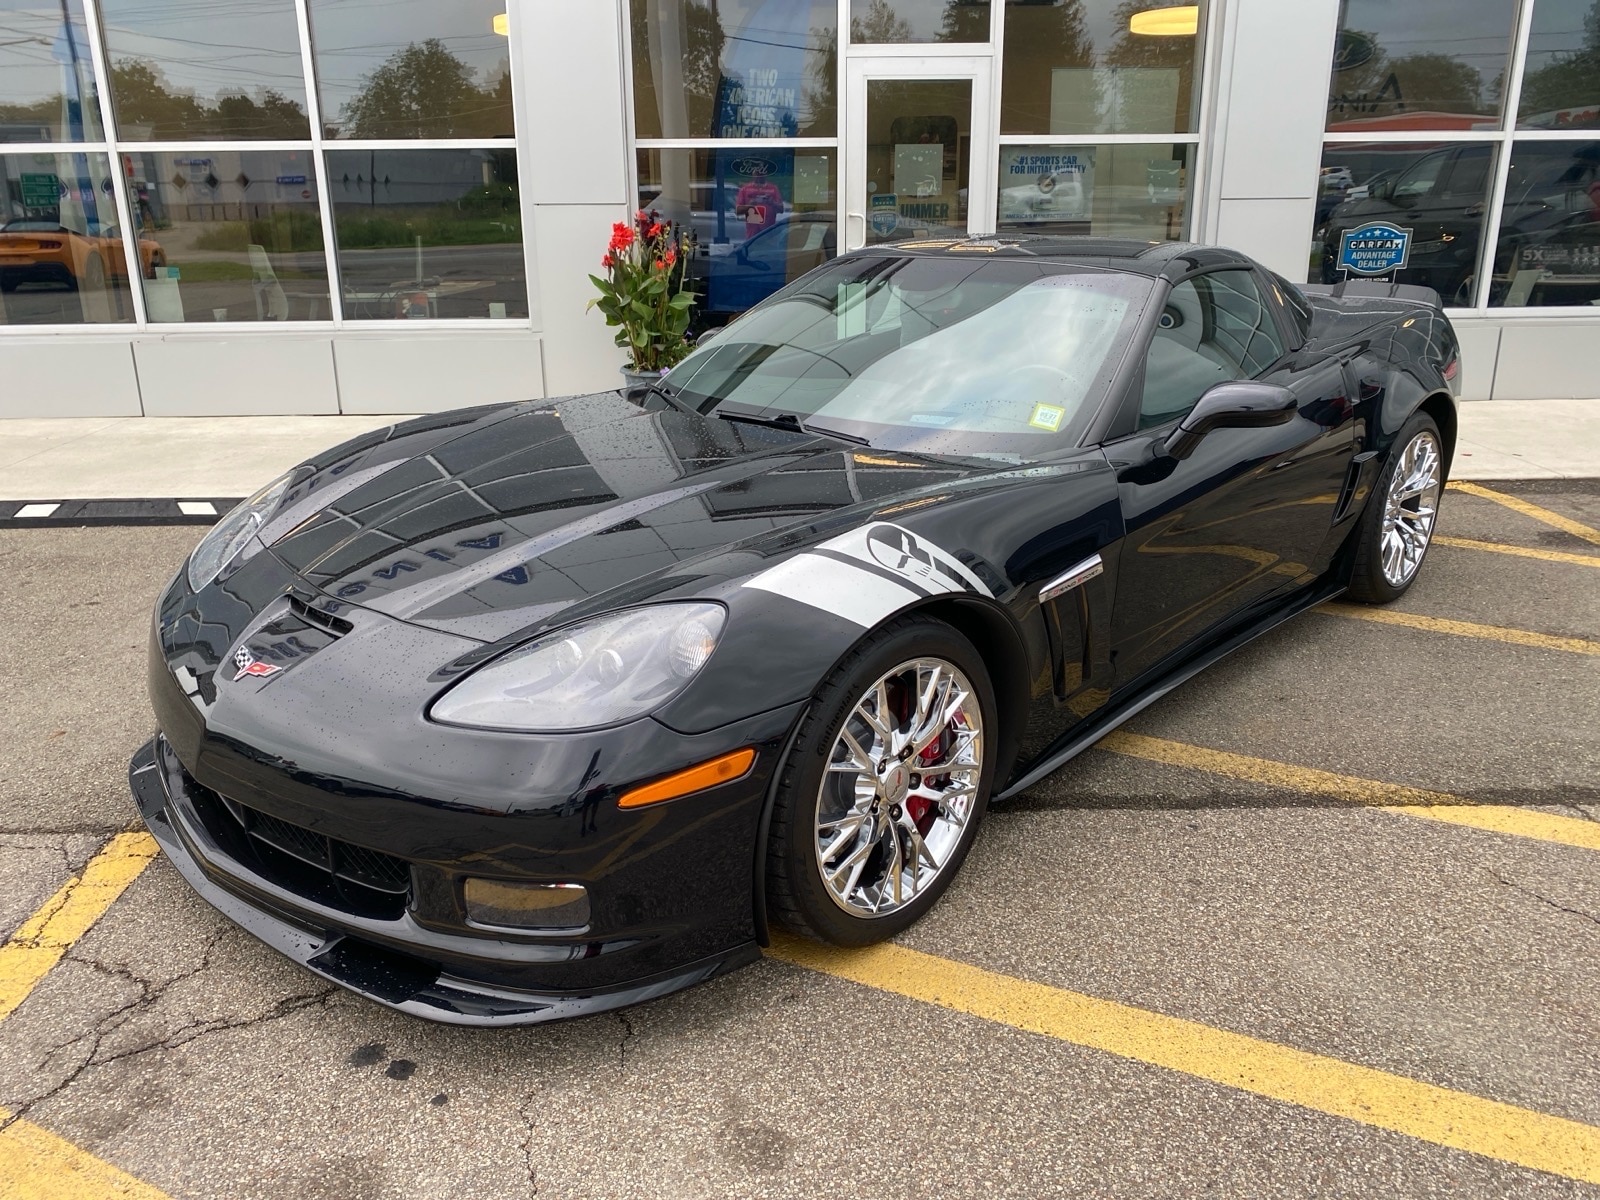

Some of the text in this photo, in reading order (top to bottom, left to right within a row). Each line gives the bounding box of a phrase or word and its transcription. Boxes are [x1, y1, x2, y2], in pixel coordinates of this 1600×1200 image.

[748, 68, 779, 87] TWO
[728, 87, 795, 107] AMERICAN
[739, 159, 769, 174] Ford
[1018, 155, 1078, 165] #1 SPORTS CAR
[1010, 164, 1087, 174] FOR INITIAL QUALITY
[899, 203, 949, 219] UMMER
[1350, 240, 1401, 249] CARFAX
[1351, 251, 1397, 260] ADVANTAGE
[1522, 249, 1544, 261] 5X
[1357, 260, 1388, 268] DEALER
[1053, 569, 1098, 595] GRAND SPORT
[817, 690, 854, 756] Continental
